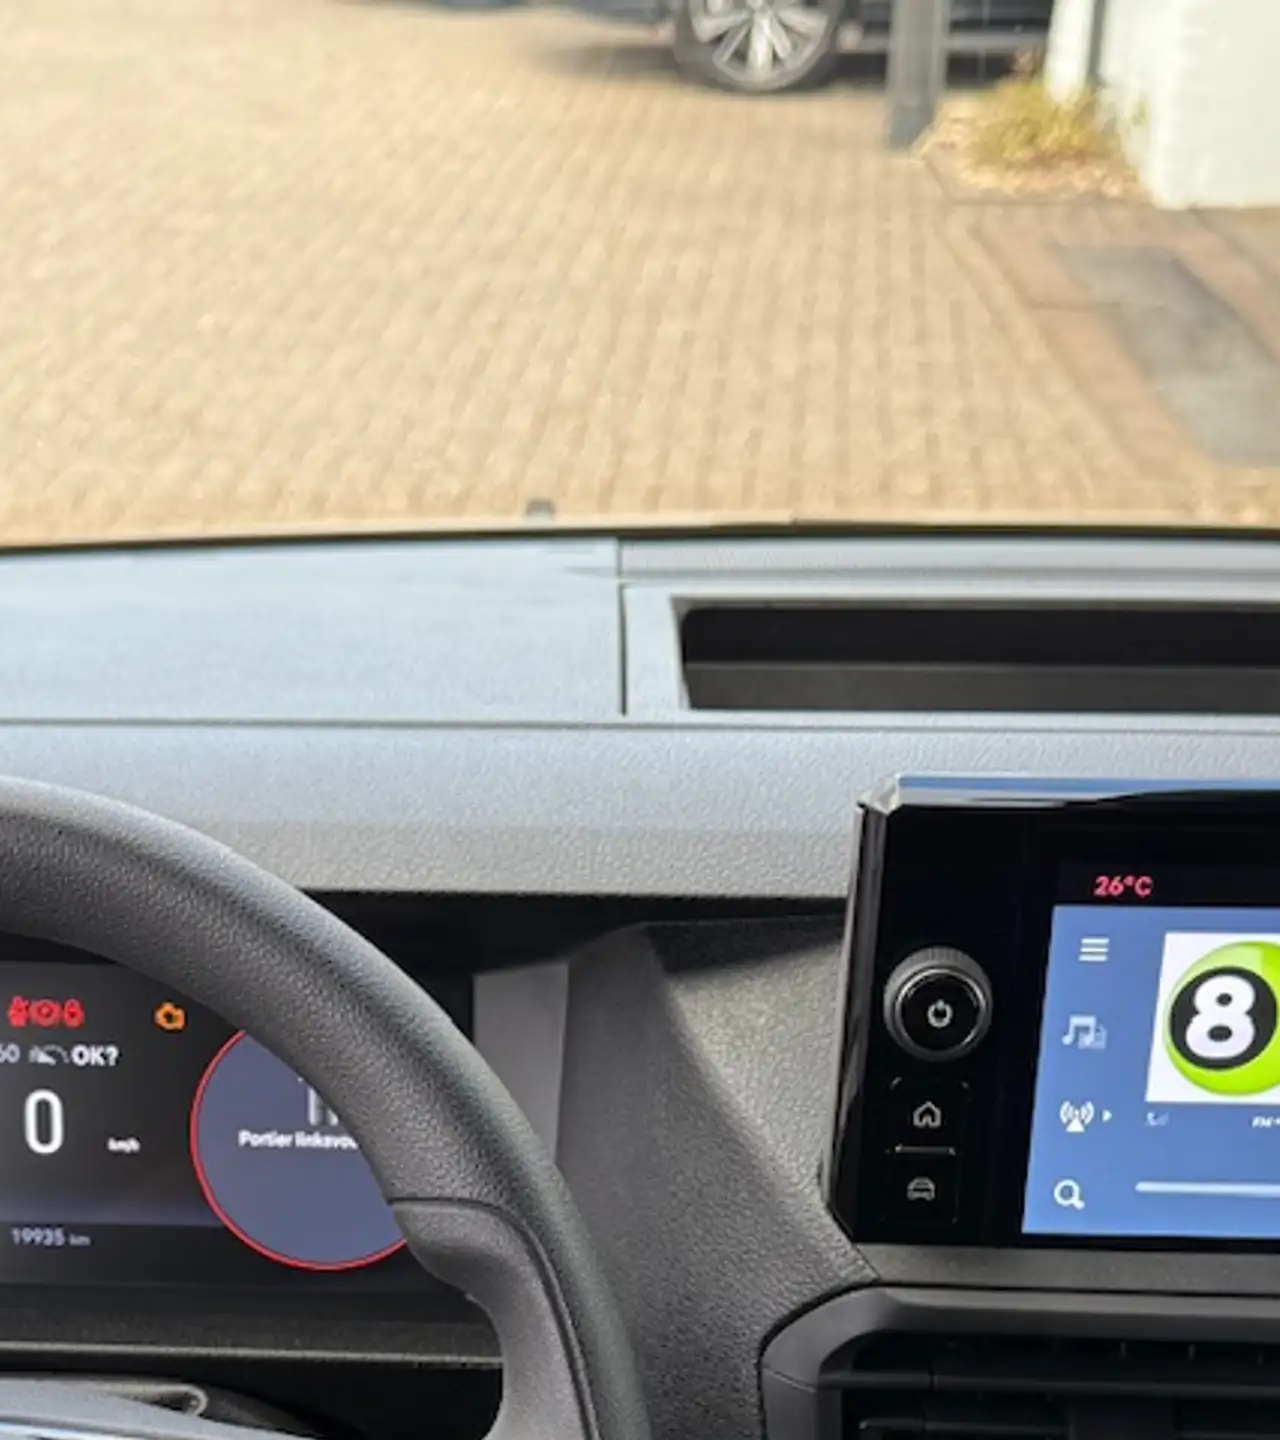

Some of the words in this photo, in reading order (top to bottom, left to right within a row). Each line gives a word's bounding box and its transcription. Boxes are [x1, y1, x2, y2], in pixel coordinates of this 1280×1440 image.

[1093, 874, 1153, 897] 26°C
[1185, 976, 1261, 1064] 8
[70, 1044, 120, 1067] OK?
[24, 1088, 64, 1154] 0
[238, 1130, 293, 1147] Portier
